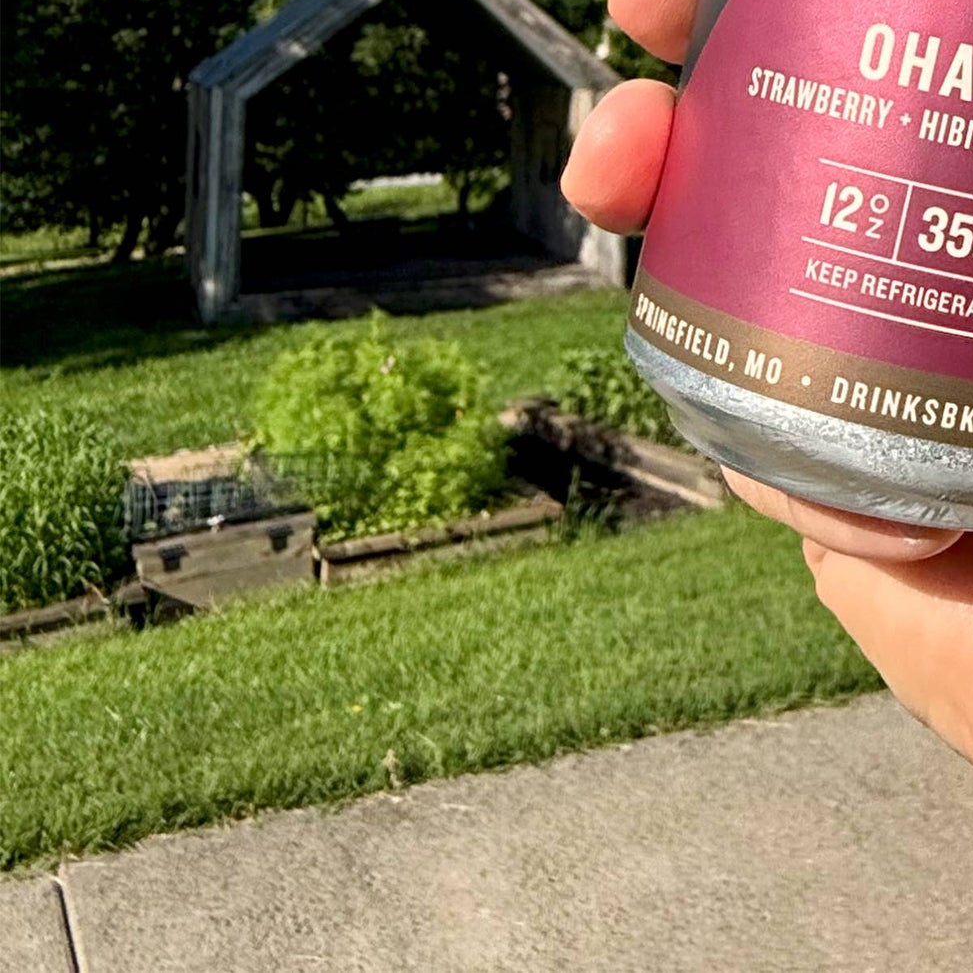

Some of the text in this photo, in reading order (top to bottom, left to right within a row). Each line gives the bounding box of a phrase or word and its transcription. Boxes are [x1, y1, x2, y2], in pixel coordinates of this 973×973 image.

[748, 67, 894, 128] STRAWBERRY
[819, 181, 863, 232] 12
[805, 259, 858, 289] KEEP
[635, 293, 735, 372] SPRINGFIELD,
[744, 349, 783, 385] MO
